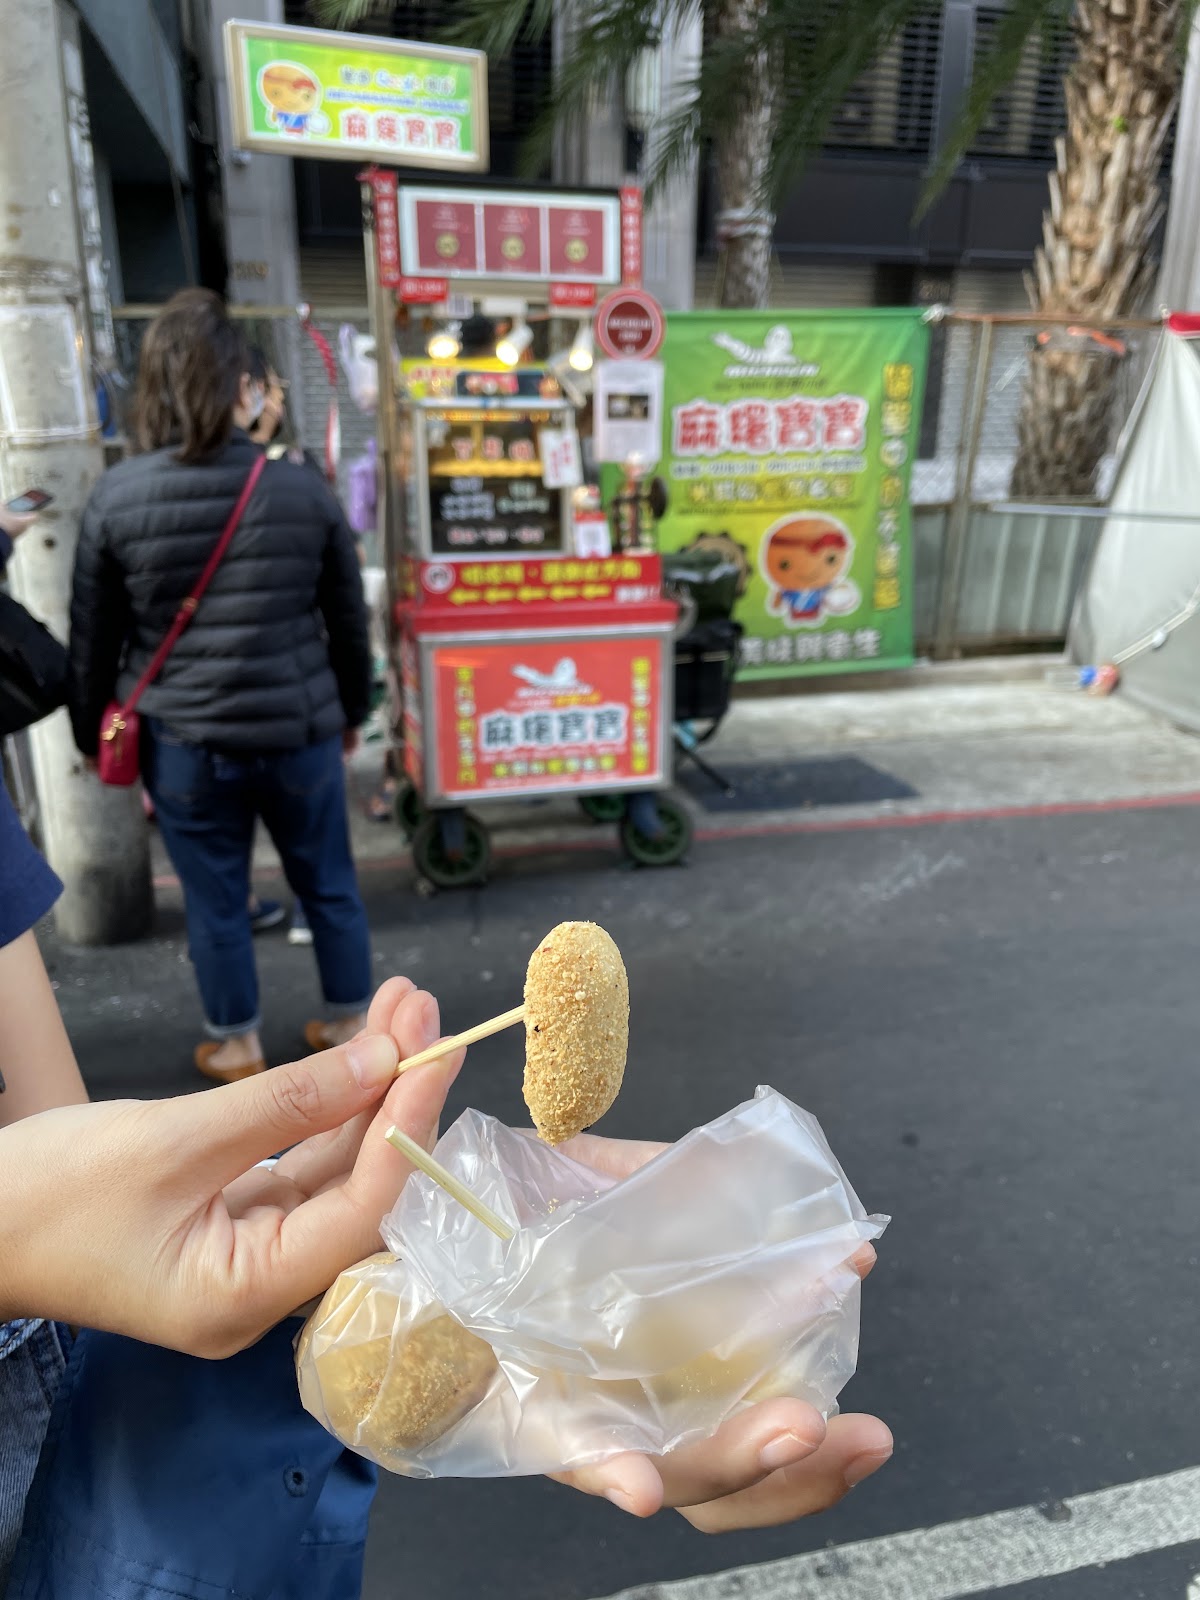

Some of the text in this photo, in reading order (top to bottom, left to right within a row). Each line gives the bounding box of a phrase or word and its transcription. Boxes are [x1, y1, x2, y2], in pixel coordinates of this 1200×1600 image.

[677, 397, 864, 450] 麻糬寶寶
[484, 707, 624, 747] 麻糬寶寶
